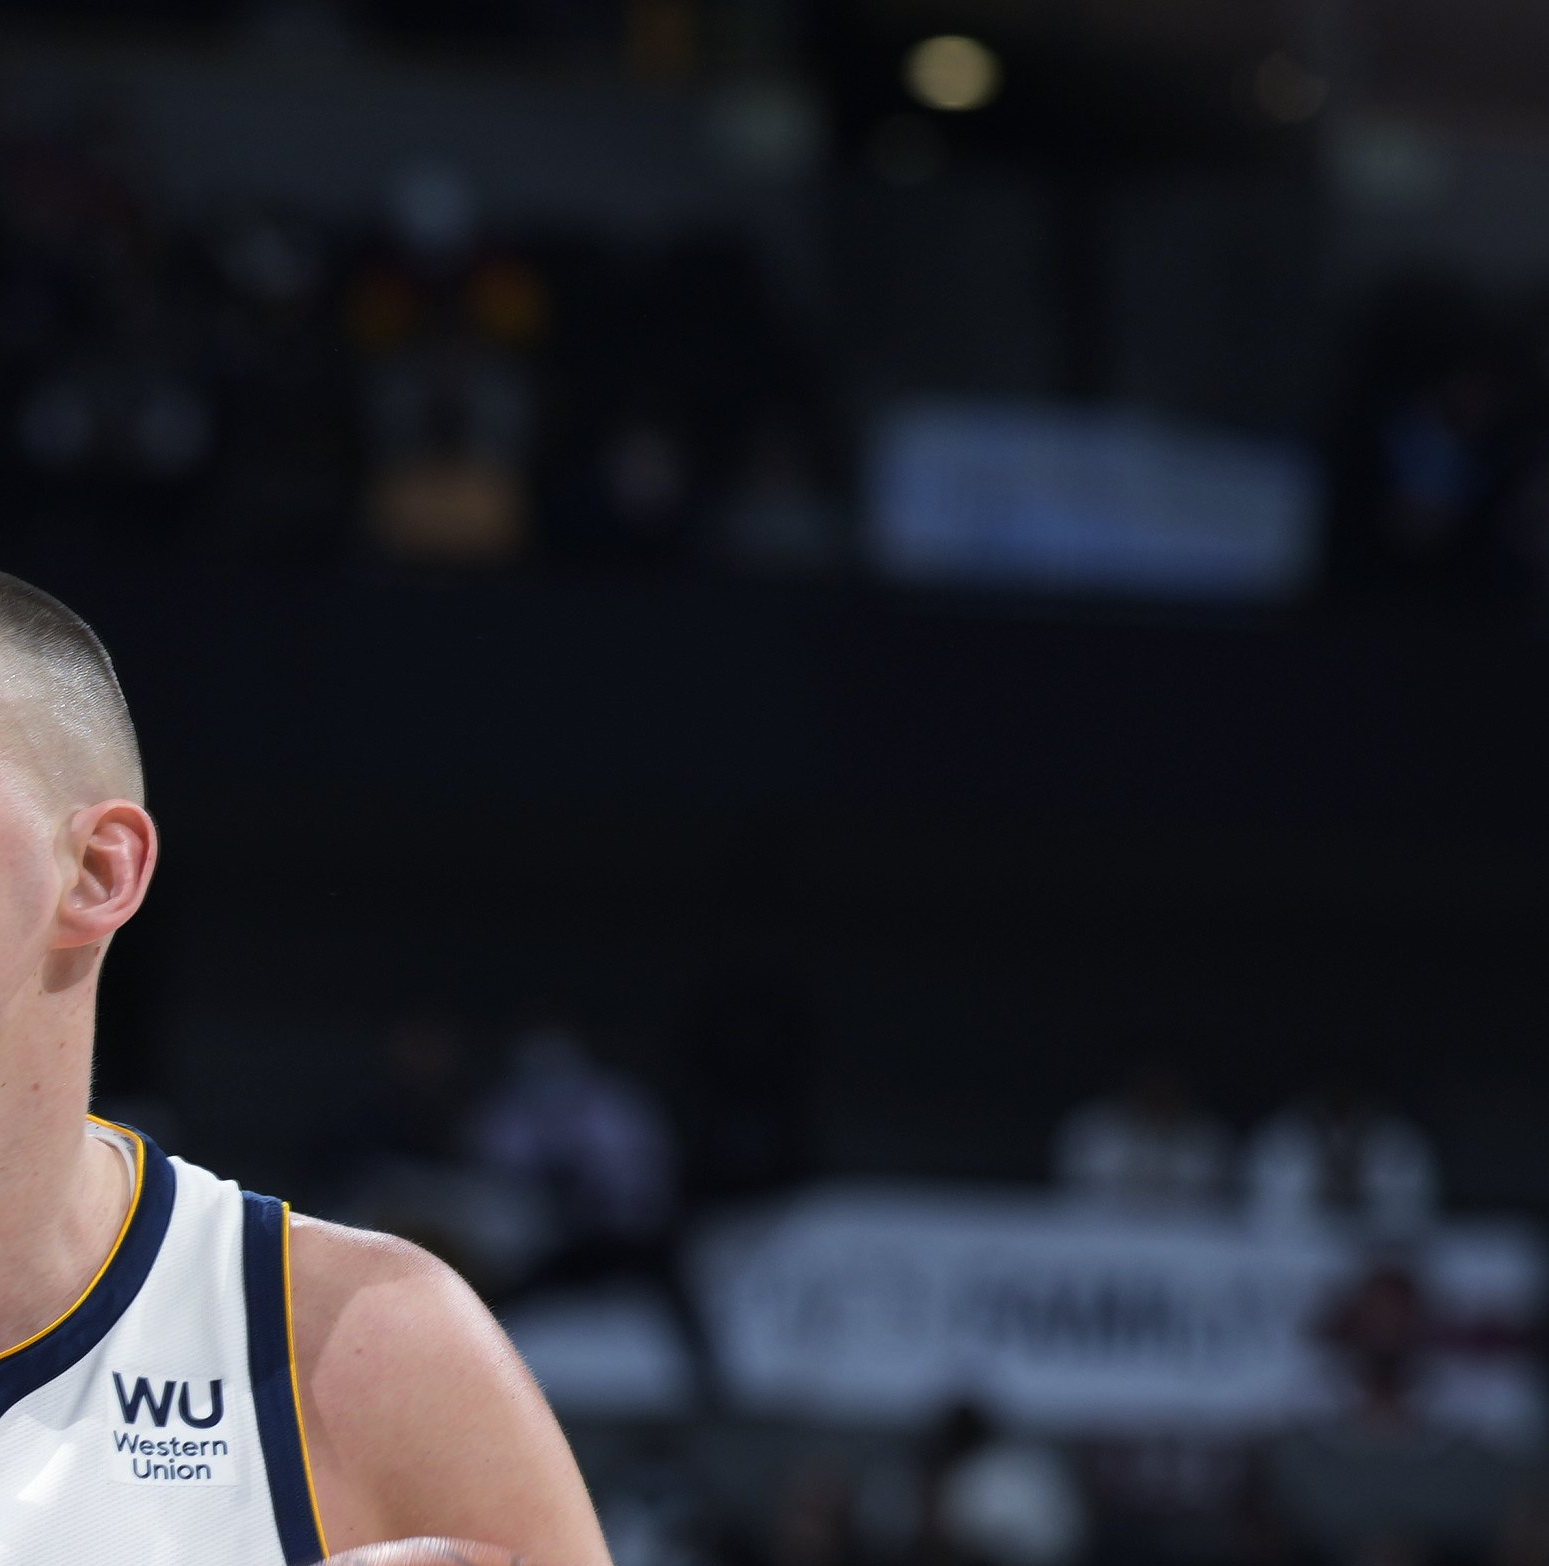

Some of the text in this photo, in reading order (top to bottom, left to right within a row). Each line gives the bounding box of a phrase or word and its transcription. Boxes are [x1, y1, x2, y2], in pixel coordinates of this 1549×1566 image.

[112, 1371, 224, 1429] WU
[113, 1430, 228, 1456] Western
[133, 1458, 212, 1480] Union
